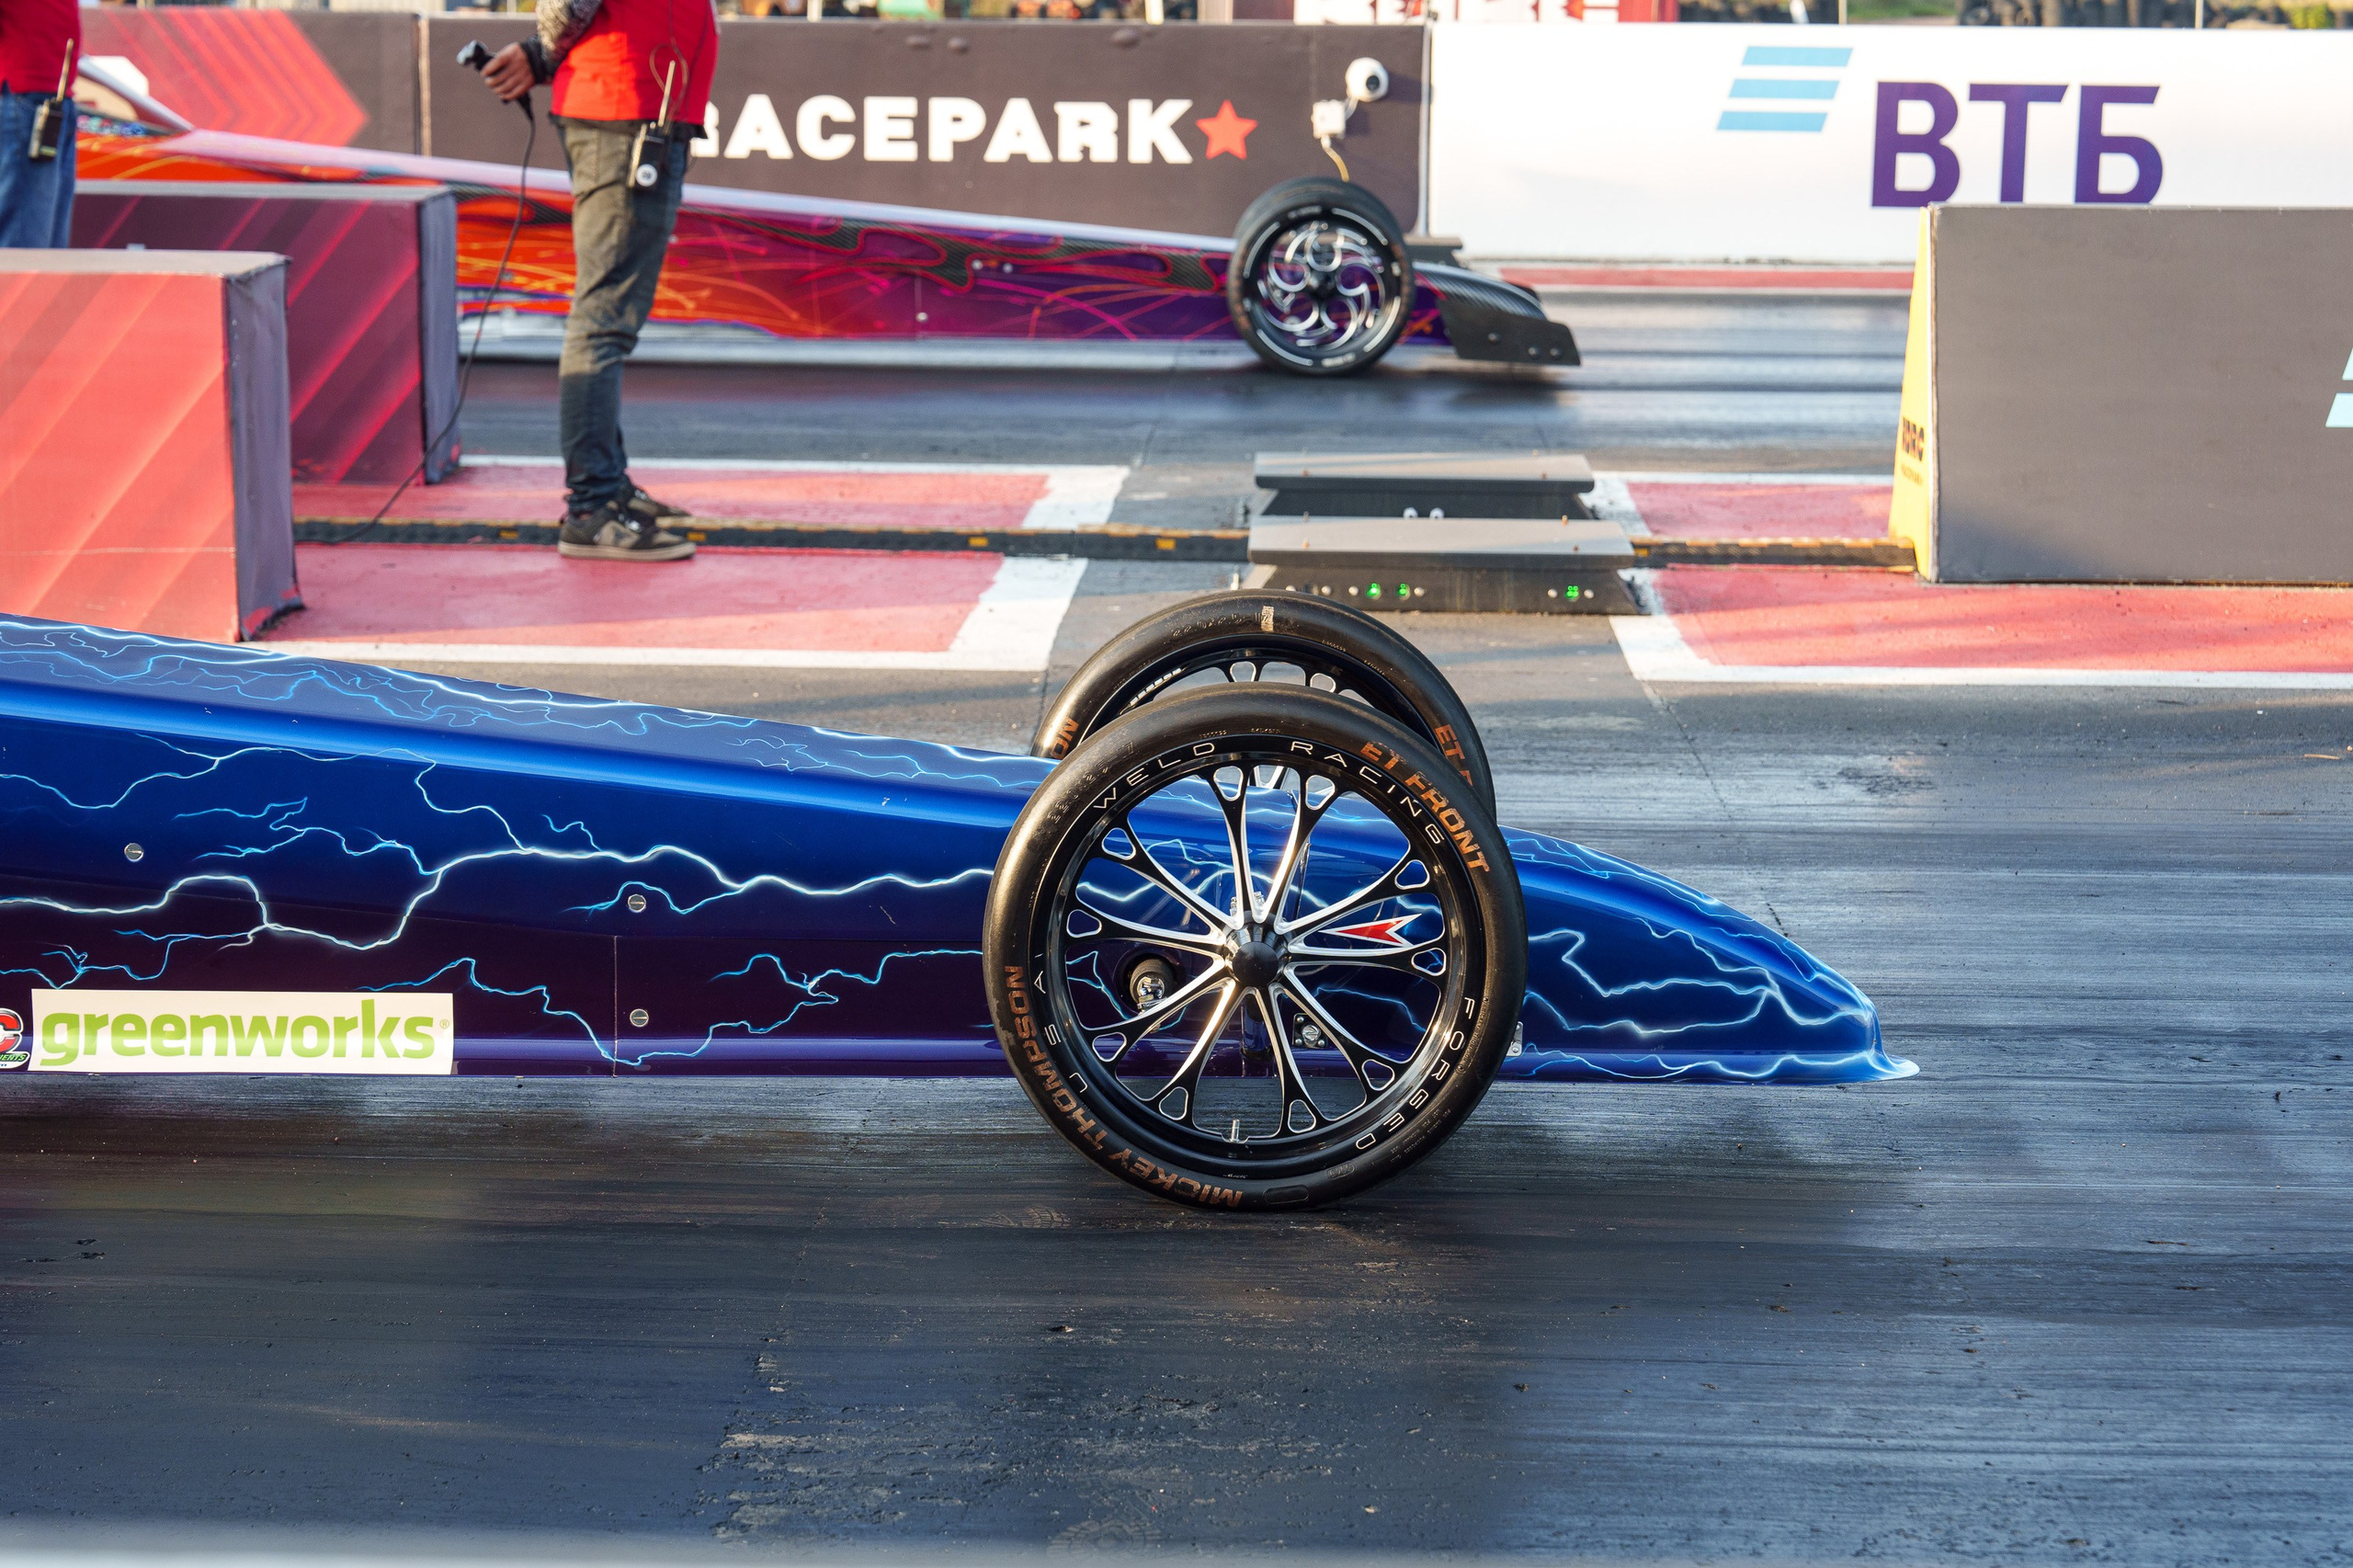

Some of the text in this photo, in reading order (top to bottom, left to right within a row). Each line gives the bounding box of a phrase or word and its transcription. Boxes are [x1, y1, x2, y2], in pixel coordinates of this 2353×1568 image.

[1871, 81, 2163, 207] ВТБ
[1093, 741, 1445, 845] WELD RACING
[1360, 741, 1491, 873] ET FRONT
[40, 999, 436, 1066] greenworks
[1005, 965, 1244, 1208] MICKEY THOMPSON
[1355, 996, 1476, 1150] FORGED
